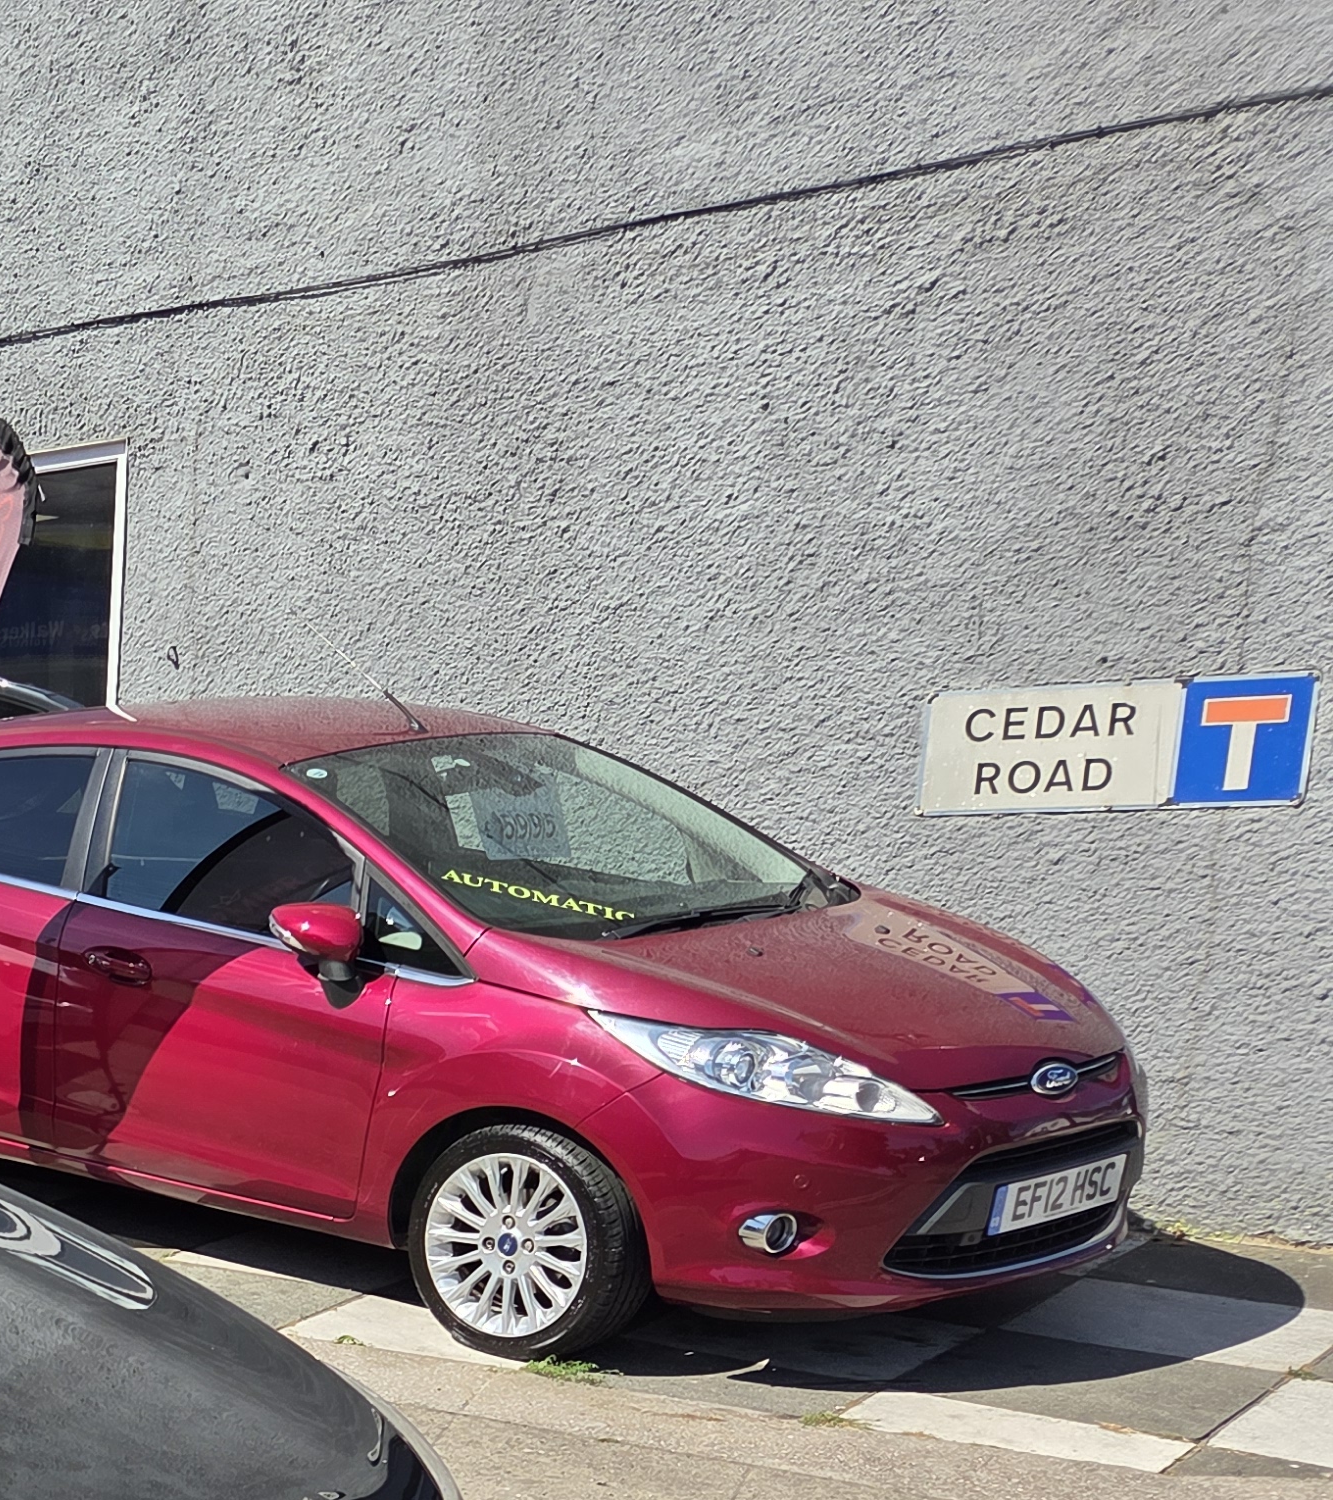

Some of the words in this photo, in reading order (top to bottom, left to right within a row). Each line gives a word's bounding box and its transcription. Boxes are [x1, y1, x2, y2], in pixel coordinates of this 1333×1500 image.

[964, 702, 1137, 742] CEDAR
[973, 758, 1113, 795] ROAD
[1011, 1176, 1069, 1222] EF12
[1070, 1161, 1116, 1206] HSC
